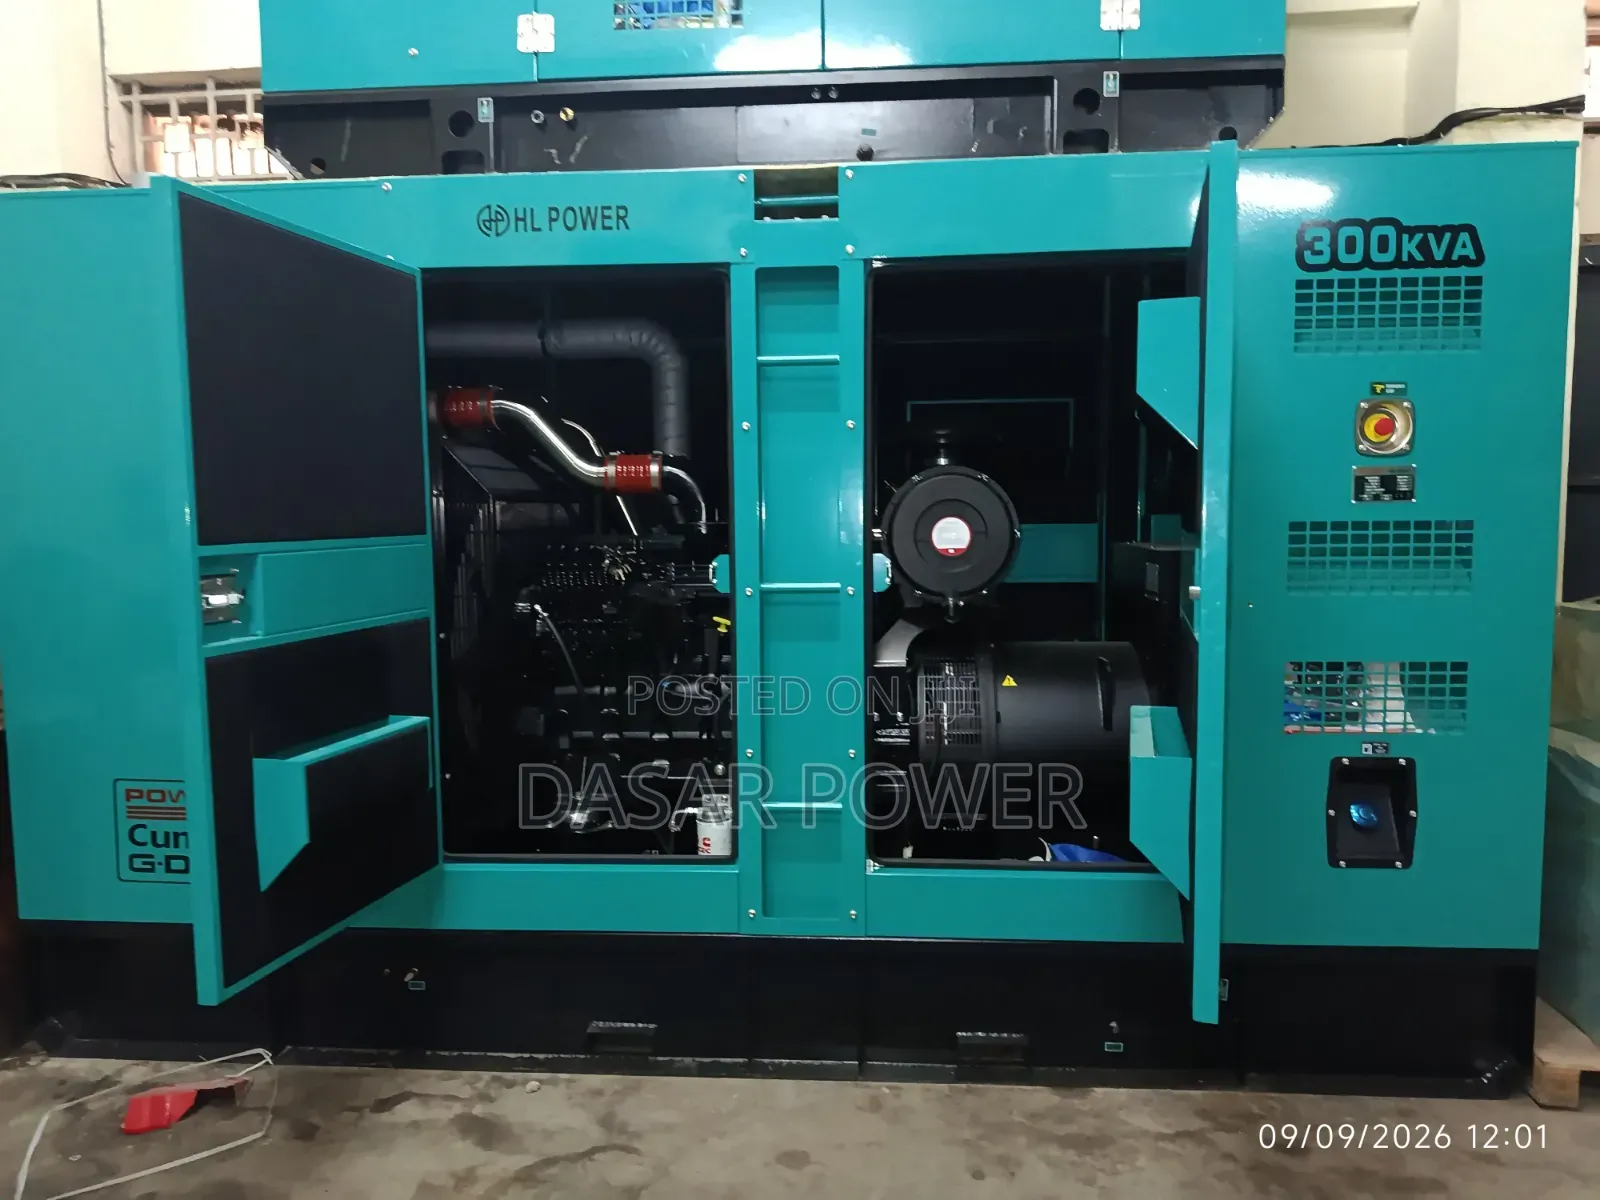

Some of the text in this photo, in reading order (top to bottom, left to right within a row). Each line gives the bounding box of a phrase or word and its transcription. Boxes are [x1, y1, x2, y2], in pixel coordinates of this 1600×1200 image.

[513, 205, 630, 233] HL POWER
[1302, 223, 1479, 266] 300KVA
